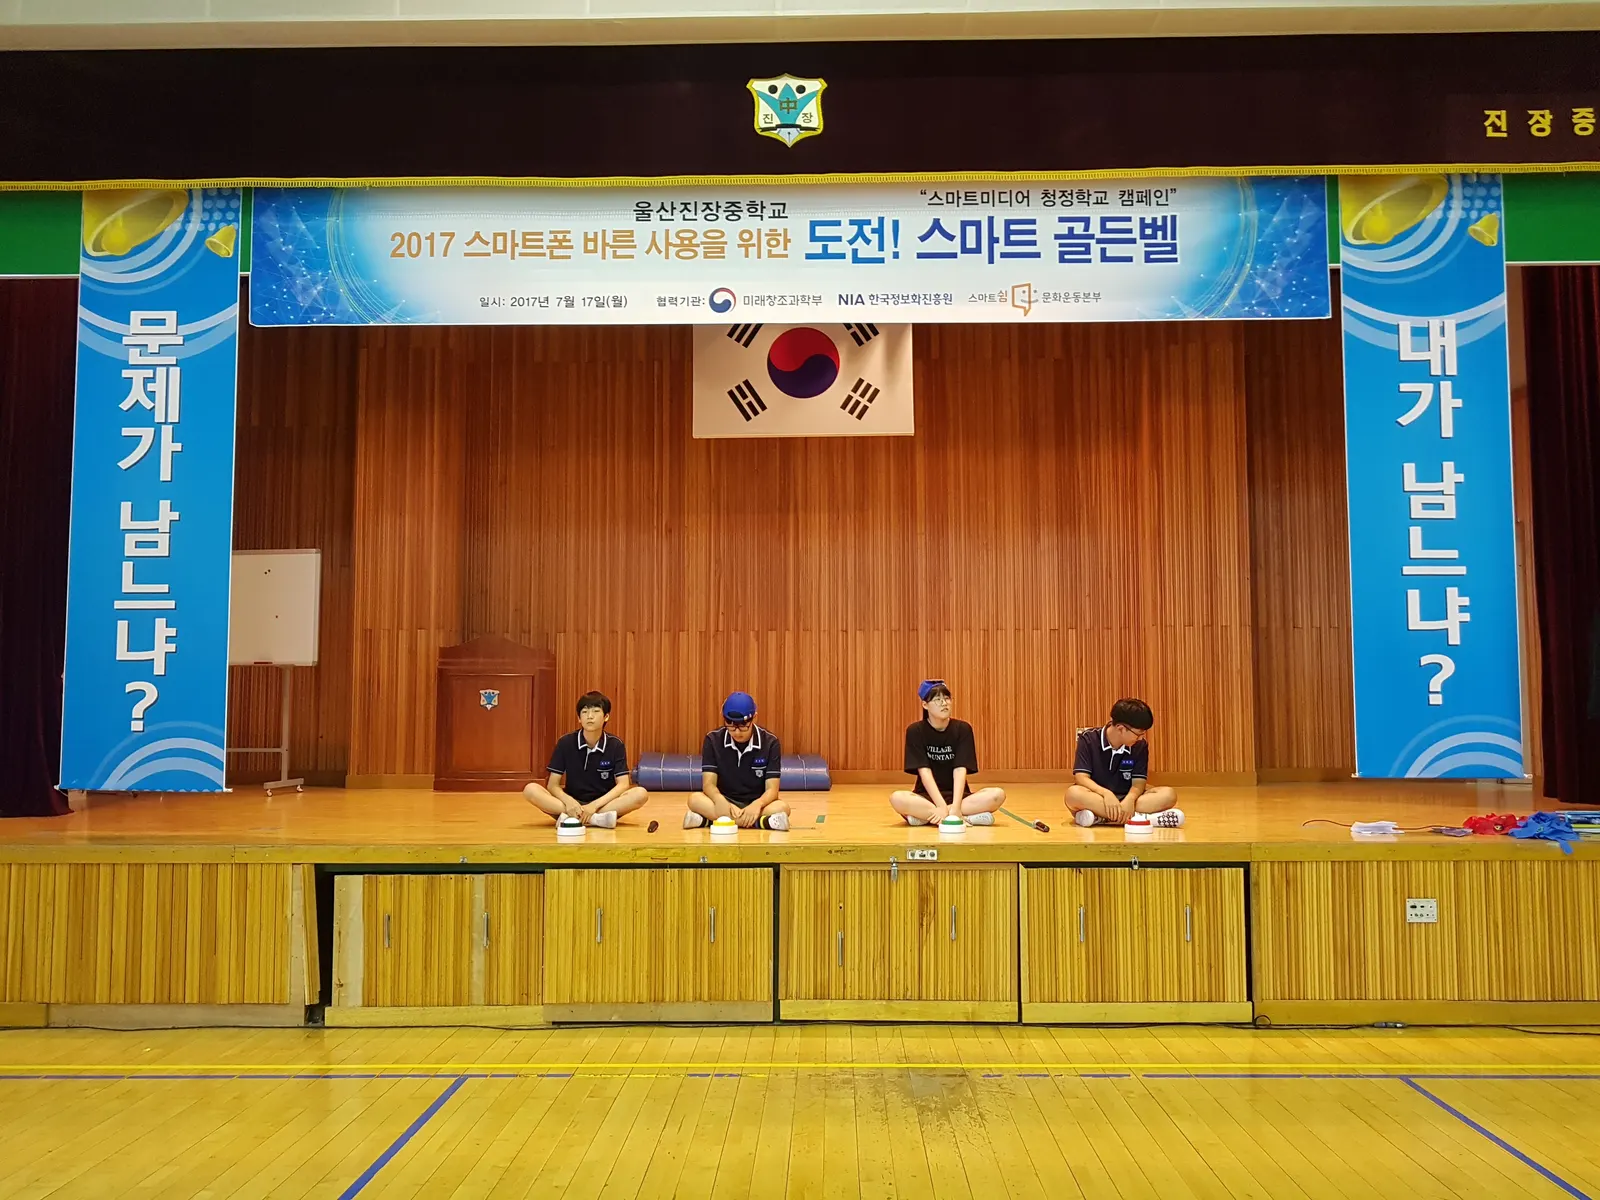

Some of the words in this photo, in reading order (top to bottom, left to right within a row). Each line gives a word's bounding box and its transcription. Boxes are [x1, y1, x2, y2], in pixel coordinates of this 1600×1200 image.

[780, 97, 798, 115] 中
[1040, 188, 1110, 208] 청정학교
[633, 200, 789, 222] 울산진장중학교
[390, 231, 456, 259] 2017
[463, 229, 575, 260] 스마트폰
[583, 228, 638, 260] 바른
[644, 228, 728, 260] 사용을
[736, 227, 792, 260] 위한
[804, 214, 900, 264] 도전!
[916, 214, 1042, 265] 스마트
[1053, 214, 1180, 264] 골든벨
[479, 296, 505, 308] 일시:
[510, 295, 550, 308] 2017년
[556, 295, 576, 308] 7월
[581, 295, 629, 309] 17일(월)
[656, 294, 705, 308] 협력기관:
[742, 294, 824, 308] 미래창조과학부
[837, 293, 866, 306] NIA
[868, 292, 954, 306] 한국정보화진흥원
[1041, 291, 1102, 304] 문화운동본부
[1396, 318, 1463, 439] 내가
[117, 310, 185, 483] 문제가
[1401, 460, 1471, 707] 남느냐?
[113, 500, 181, 733] 남느냐?
